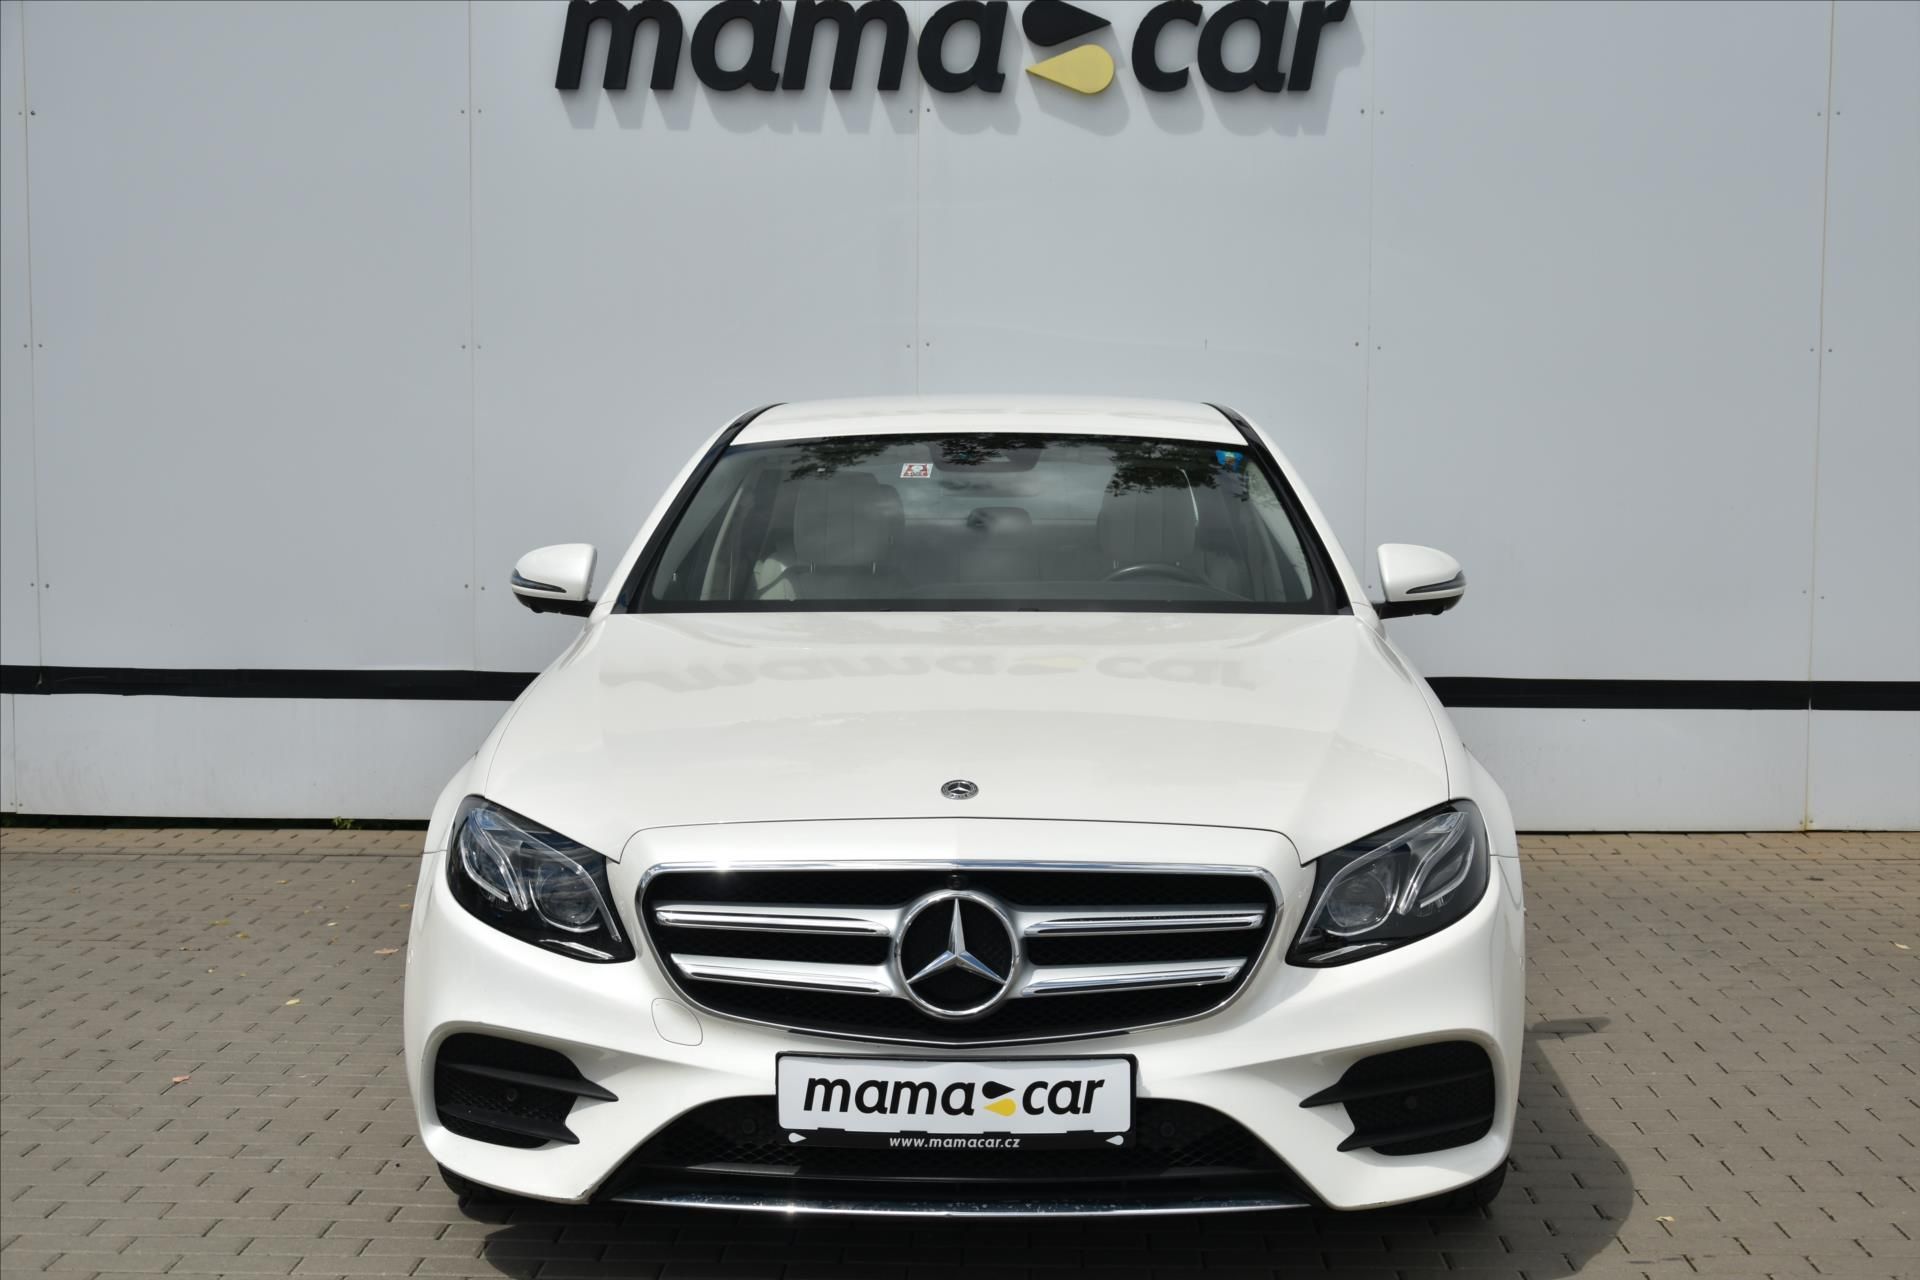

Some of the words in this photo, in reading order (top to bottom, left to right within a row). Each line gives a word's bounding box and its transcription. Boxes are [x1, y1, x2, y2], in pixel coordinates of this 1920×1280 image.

[803, 1077, 976, 1117] mama
[1022, 1078, 1106, 1117] car
[889, 1136, 1021, 1149] www.mamacar.cz
